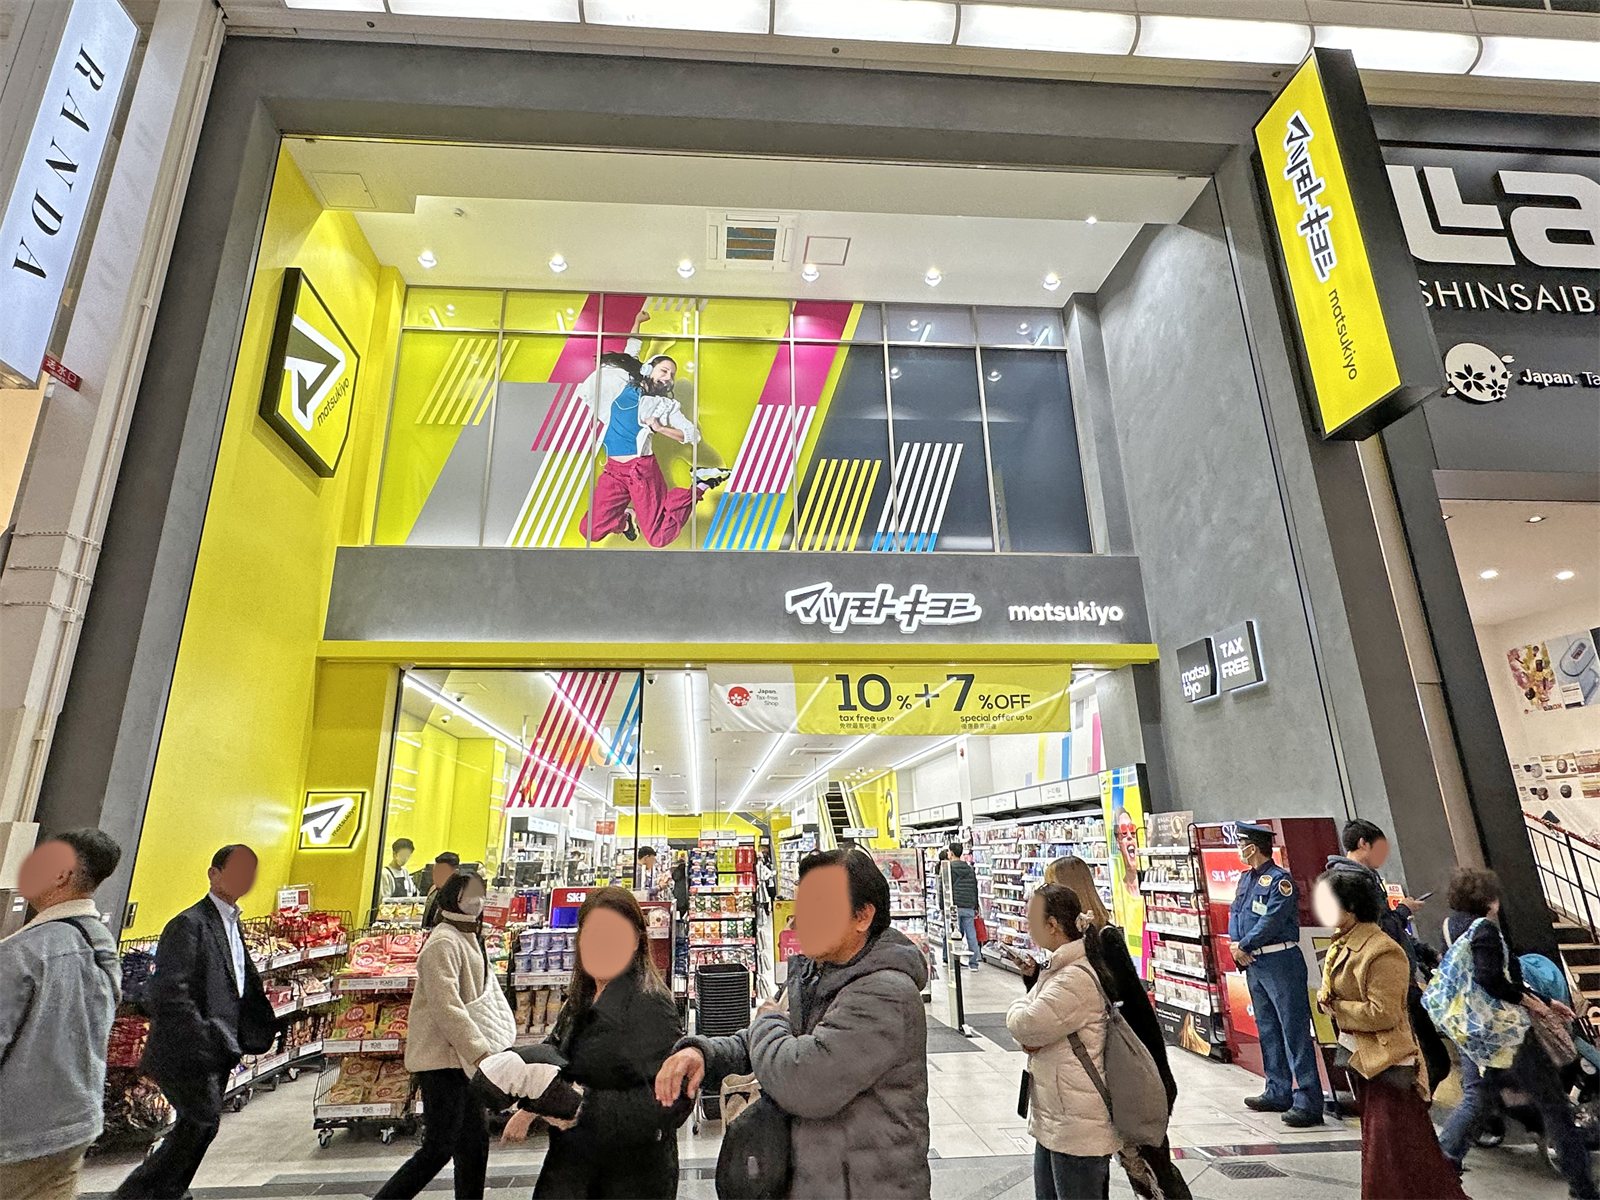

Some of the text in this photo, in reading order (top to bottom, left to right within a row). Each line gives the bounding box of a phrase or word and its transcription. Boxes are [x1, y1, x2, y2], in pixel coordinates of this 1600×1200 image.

[12, 43, 106, 279] RANDA
[1284, 110, 1337, 283] マツモトキヨシ
[1328, 288, 1358, 381] matsukiyo
[1522, 368, 1578, 386] Japan.
[317, 378, 350, 427] matsukiyo
[785, 582, 982, 633] マツモトキヨシ
[1008, 601, 1124, 625] matsukiyo
[1219, 637, 1244, 658] TAX
[1181, 664, 1210, 683] matsu
[1220, 655, 1250, 678] FREE
[839, 714, 854, 722] tax
[960, 714, 991, 723] special
[992, 714, 1015, 722] offer
[332, 806, 357, 836] matsukiyo
